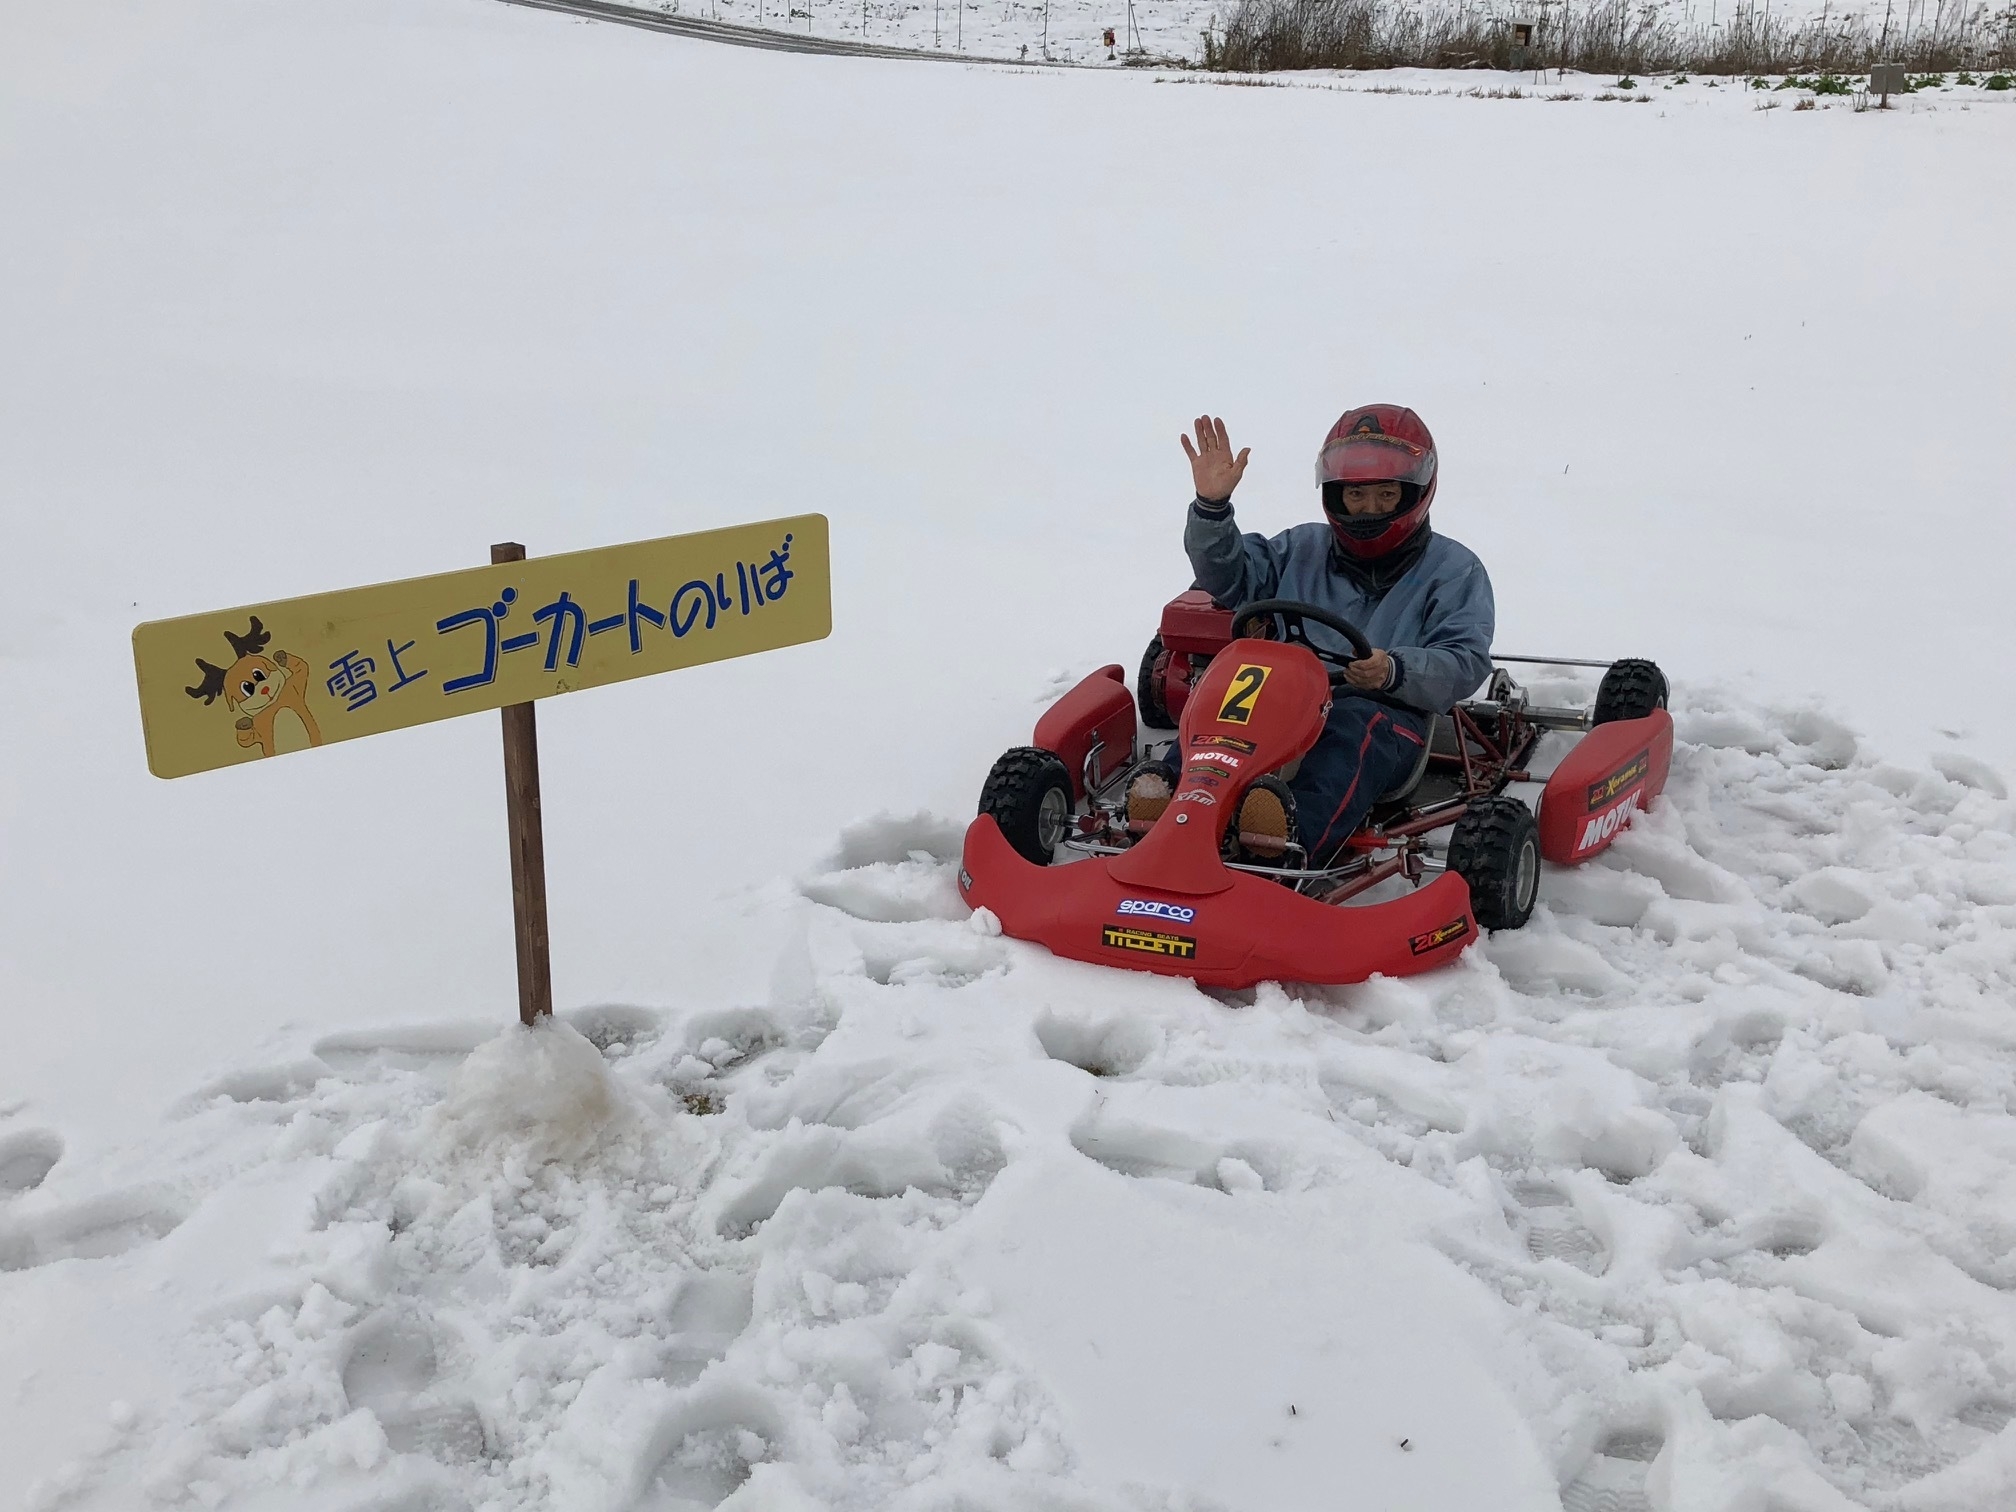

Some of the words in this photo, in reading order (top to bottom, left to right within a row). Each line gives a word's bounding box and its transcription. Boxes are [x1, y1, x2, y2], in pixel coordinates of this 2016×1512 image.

[1218, 666, 1265, 723] 2
[1190, 752, 1239, 768] MOTUL
[1118, 900, 1194, 921] sparco
[1126, 928, 1152, 937] RACING
